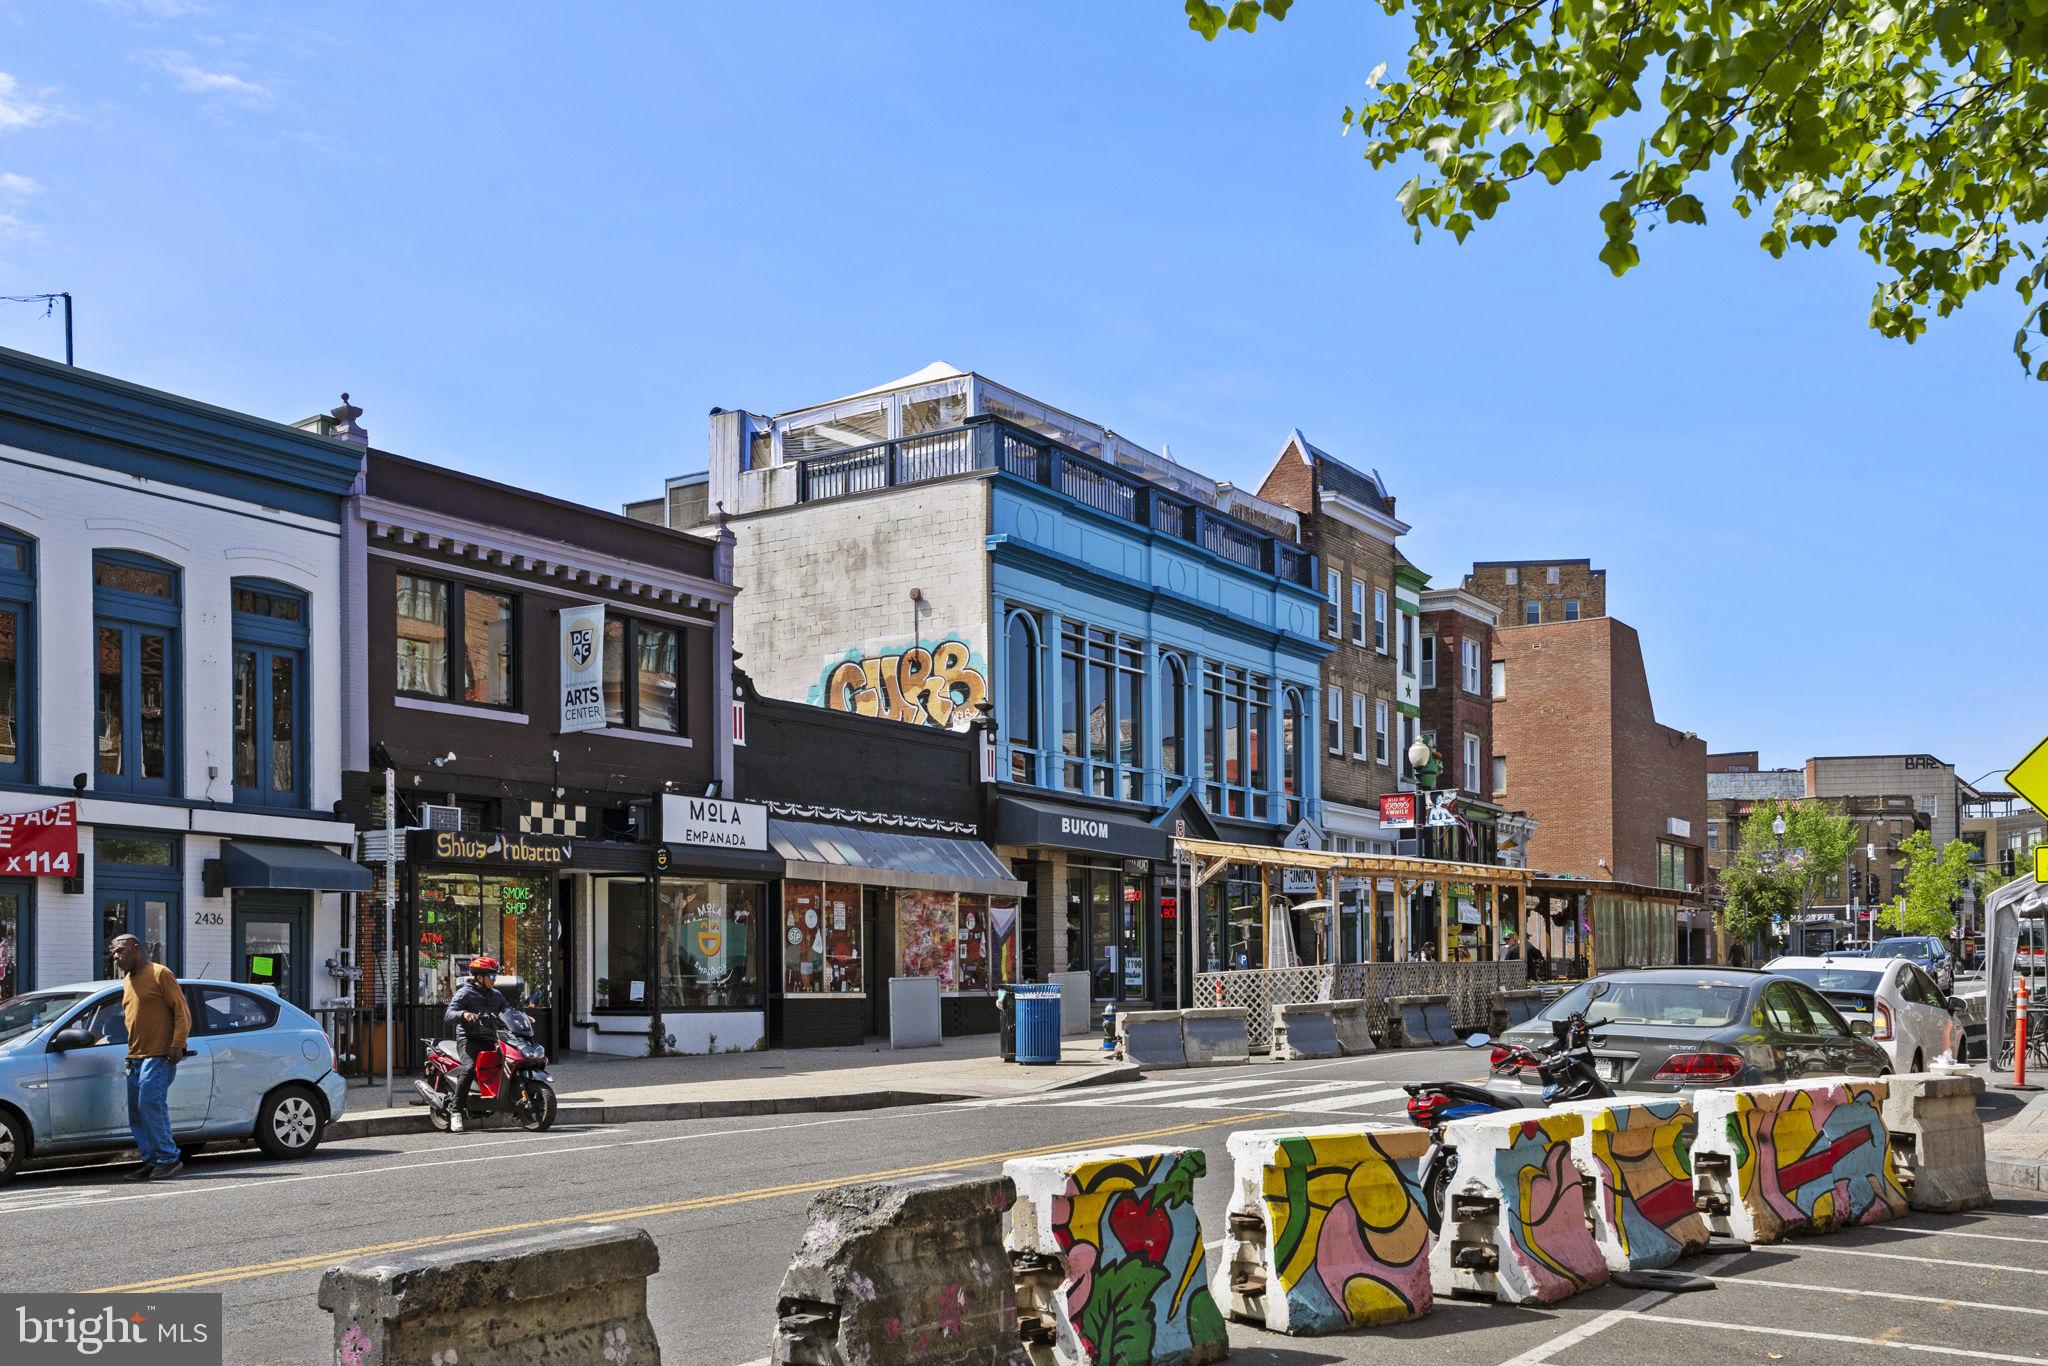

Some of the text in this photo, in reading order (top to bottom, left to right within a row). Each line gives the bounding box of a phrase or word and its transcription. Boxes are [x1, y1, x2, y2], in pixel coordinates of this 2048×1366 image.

[565, 686, 599, 707] ARTS
[565, 705, 601, 721] CENTER
[690, 800, 741, 825] MOLA
[1061, 817, 1109, 839] BUKOM
[686, 829, 747, 847] EMPANADA
[503, 886, 529, 900] SMOKE
[505, 901, 527, 915] SHOP
[697, 902, 722, 917] MOLA
[194, 911, 225, 925] 2436
[421, 932, 443, 945] ATM
[789, 929, 801, 942] STP
